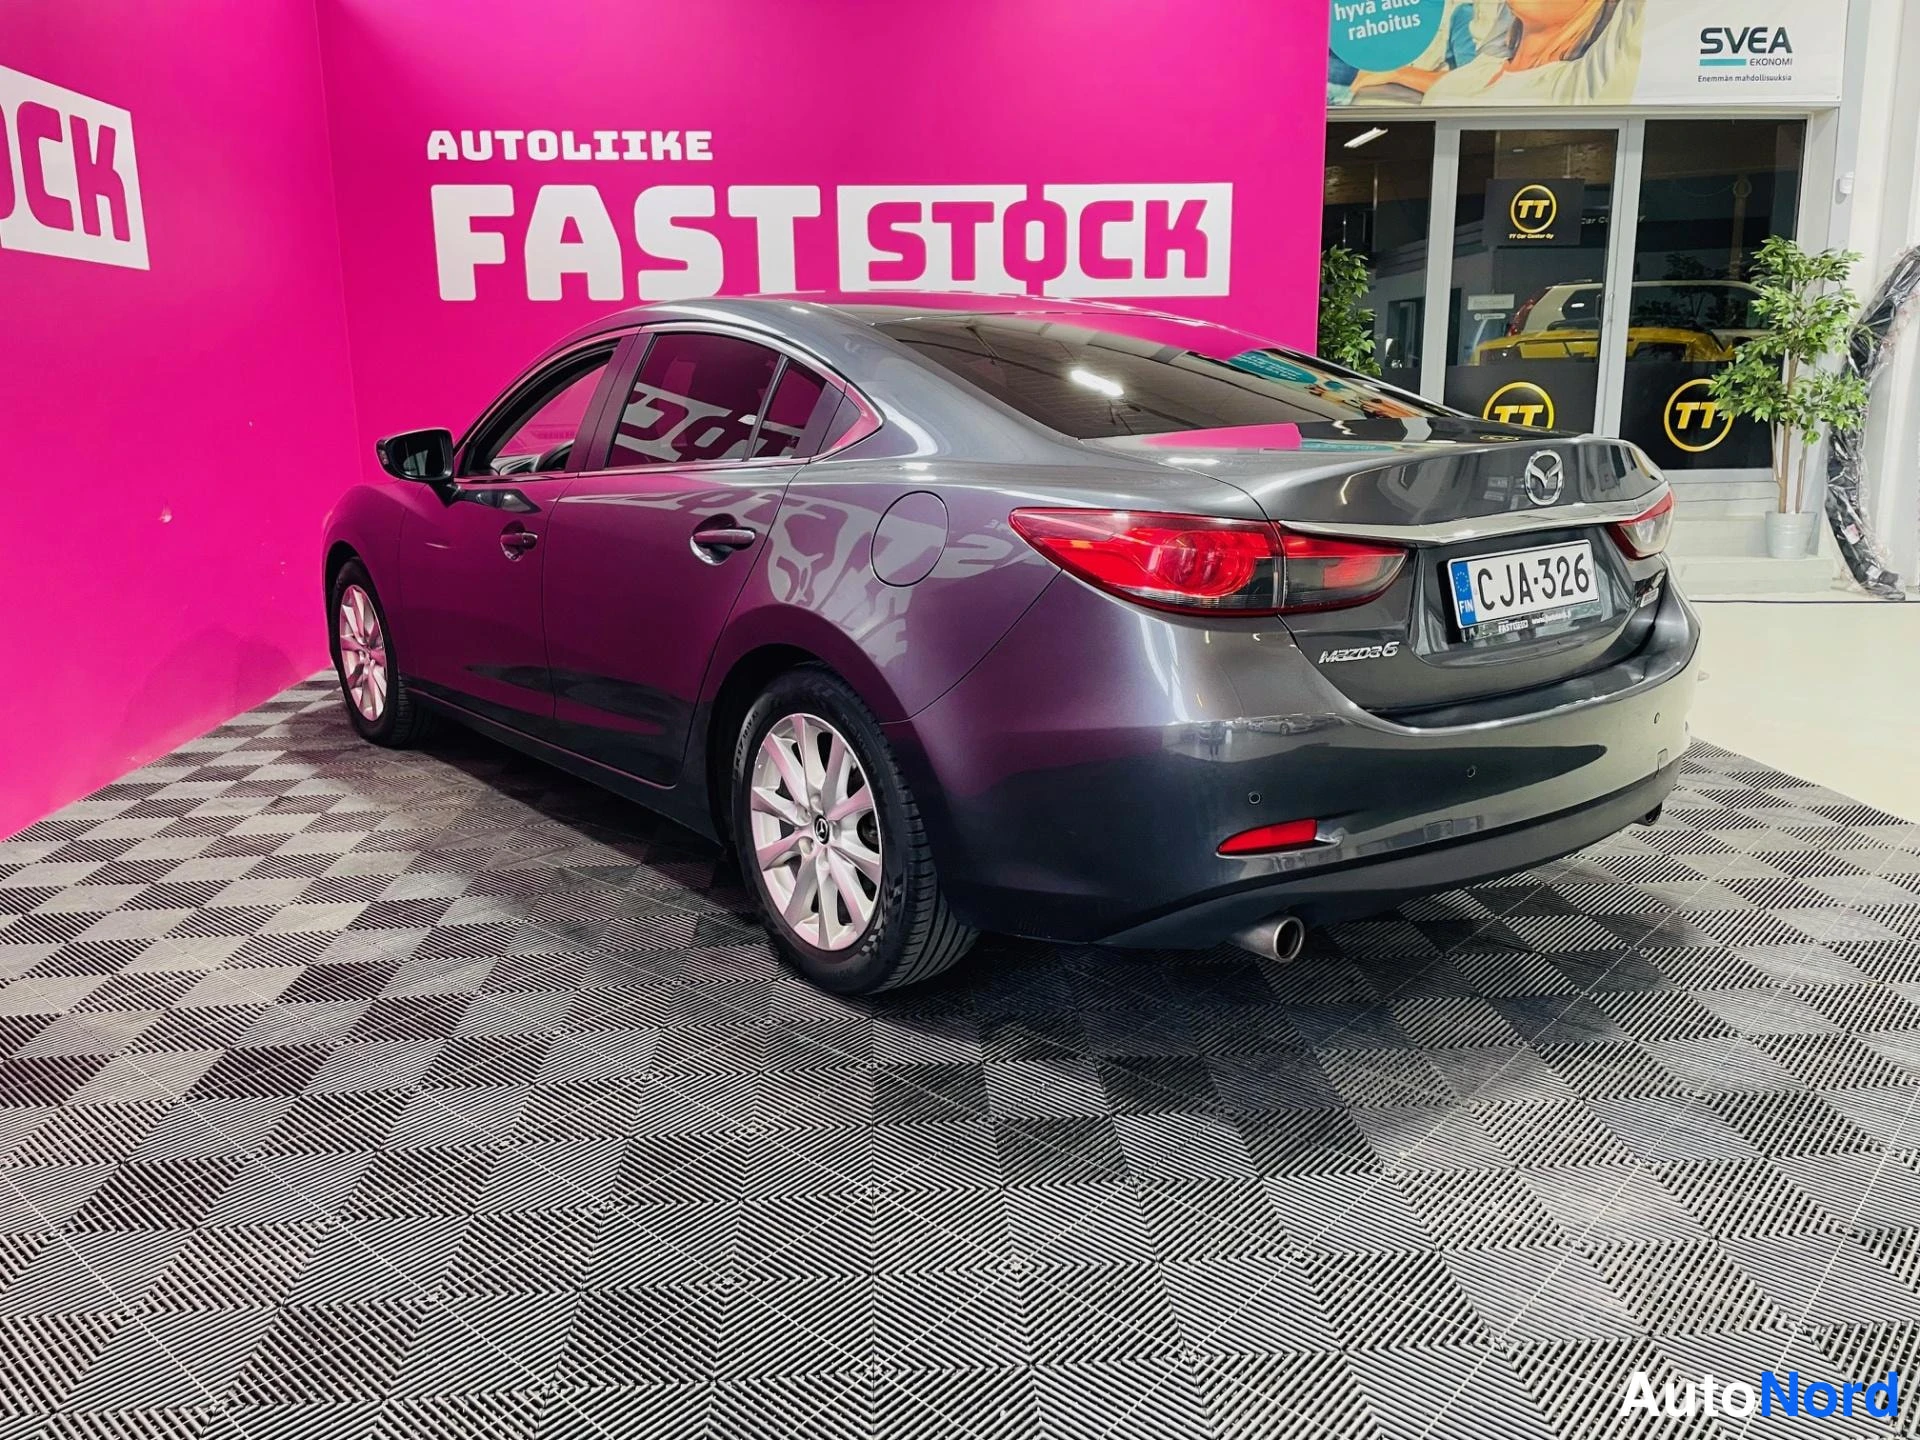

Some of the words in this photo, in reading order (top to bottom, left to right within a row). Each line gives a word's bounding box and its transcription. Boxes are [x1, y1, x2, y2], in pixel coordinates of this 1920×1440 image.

[1348, 14, 1420, 40] rahoitus
[1700, 27, 1793, 54] SVEA
[1749, 58, 1793, 66] EKONOMI
[1735, 73, 1792, 82] mahdollisuuksia
[427, 130, 713, 161] AUTOLIIKE
[1518, 200, 1550, 219] TT
[431, 185, 820, 301] FAST
[867, 200, 1208, 282] STOCK
[1494, 404, 1544, 428] TT
[1675, 401, 1720, 429] TT
[1477, 553, 1590, 611] CJA-326
[1458, 600, 1475, 614] FIN
